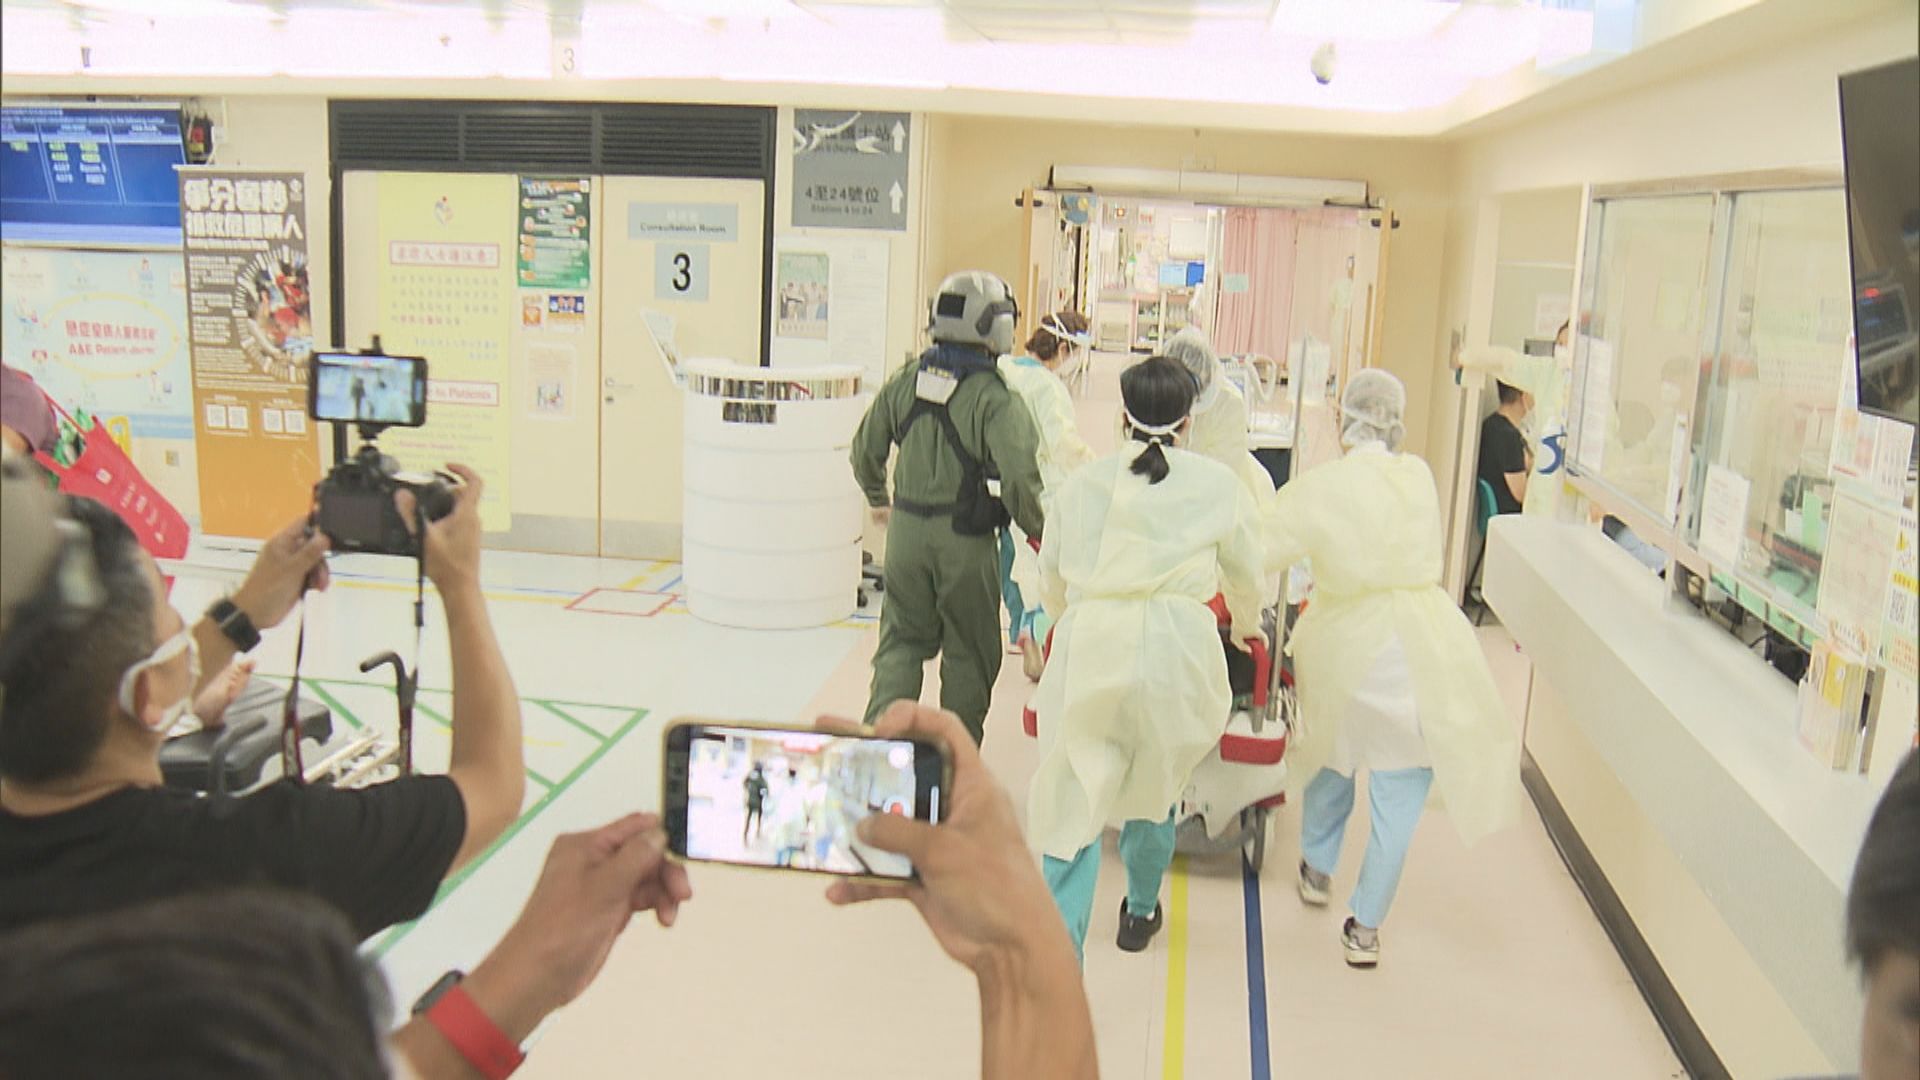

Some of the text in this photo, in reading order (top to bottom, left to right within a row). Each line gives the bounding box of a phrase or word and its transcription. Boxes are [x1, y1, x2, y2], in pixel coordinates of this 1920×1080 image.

[562, 47, 575, 73] 3
[640, 222, 726, 233] Consultation Room
[672, 252, 691, 292] 3
[69, 343, 93, 355] A&E
[449, 387, 493, 400] Patients
